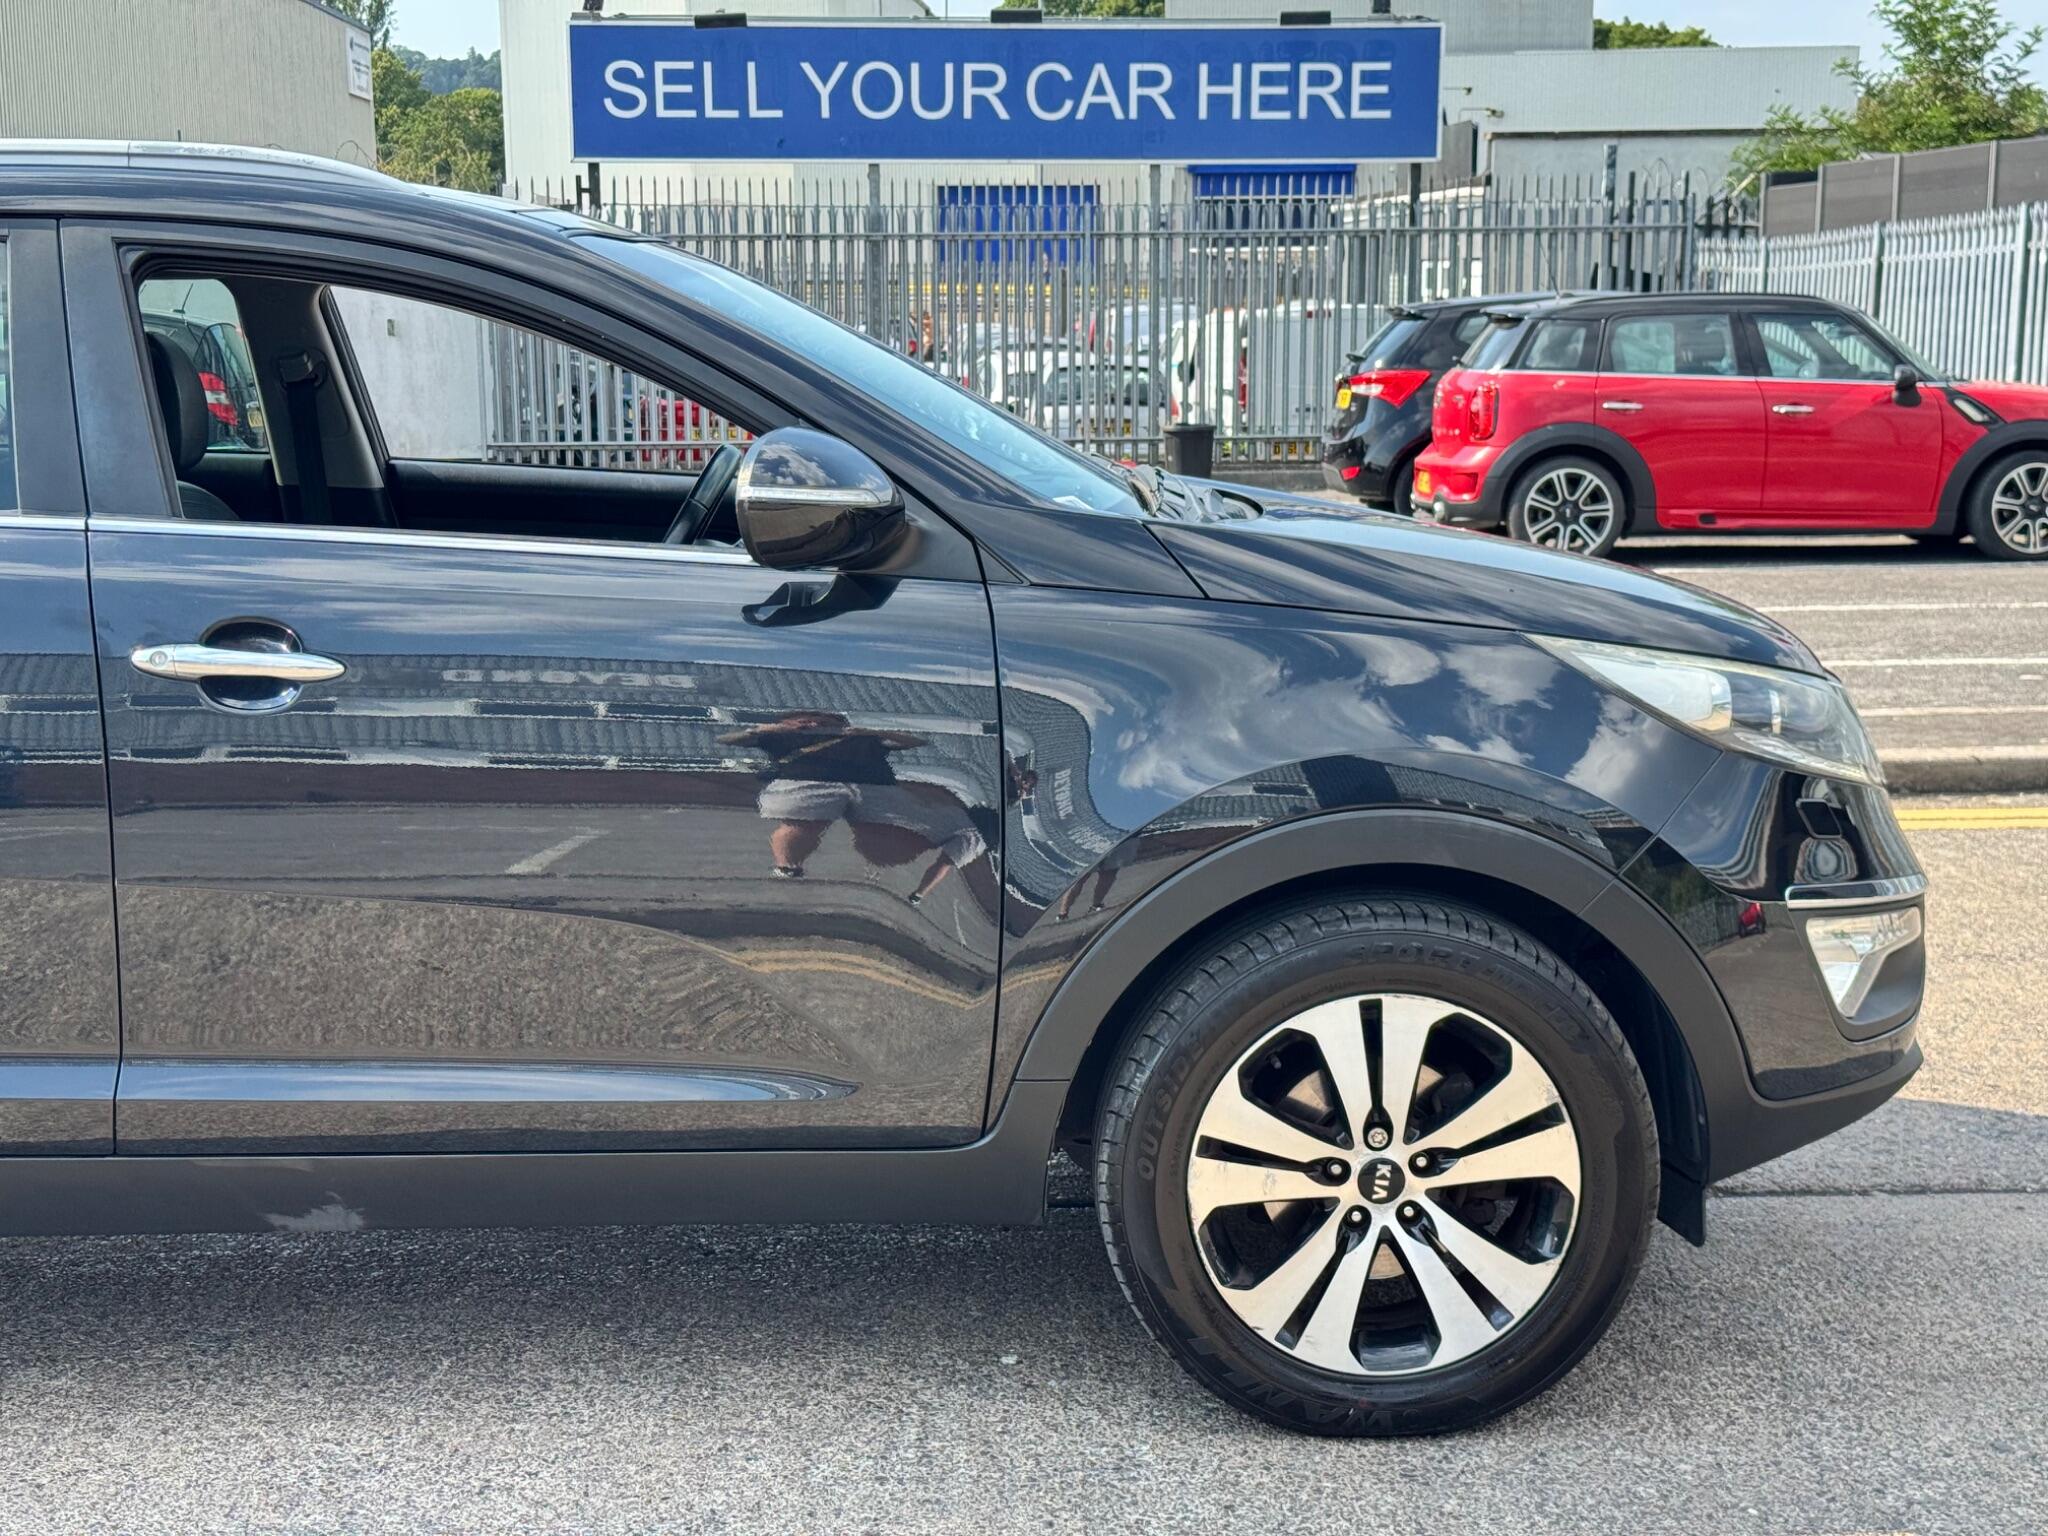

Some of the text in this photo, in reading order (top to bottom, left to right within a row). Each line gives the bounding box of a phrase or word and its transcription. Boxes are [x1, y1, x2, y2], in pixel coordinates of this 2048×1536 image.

[603, 59, 1393, 121] SELL YOUR CAR HERE
[1136, 1031, 1206, 1181] OUTSIDE
[1371, 1163, 1392, 1200] KIA
